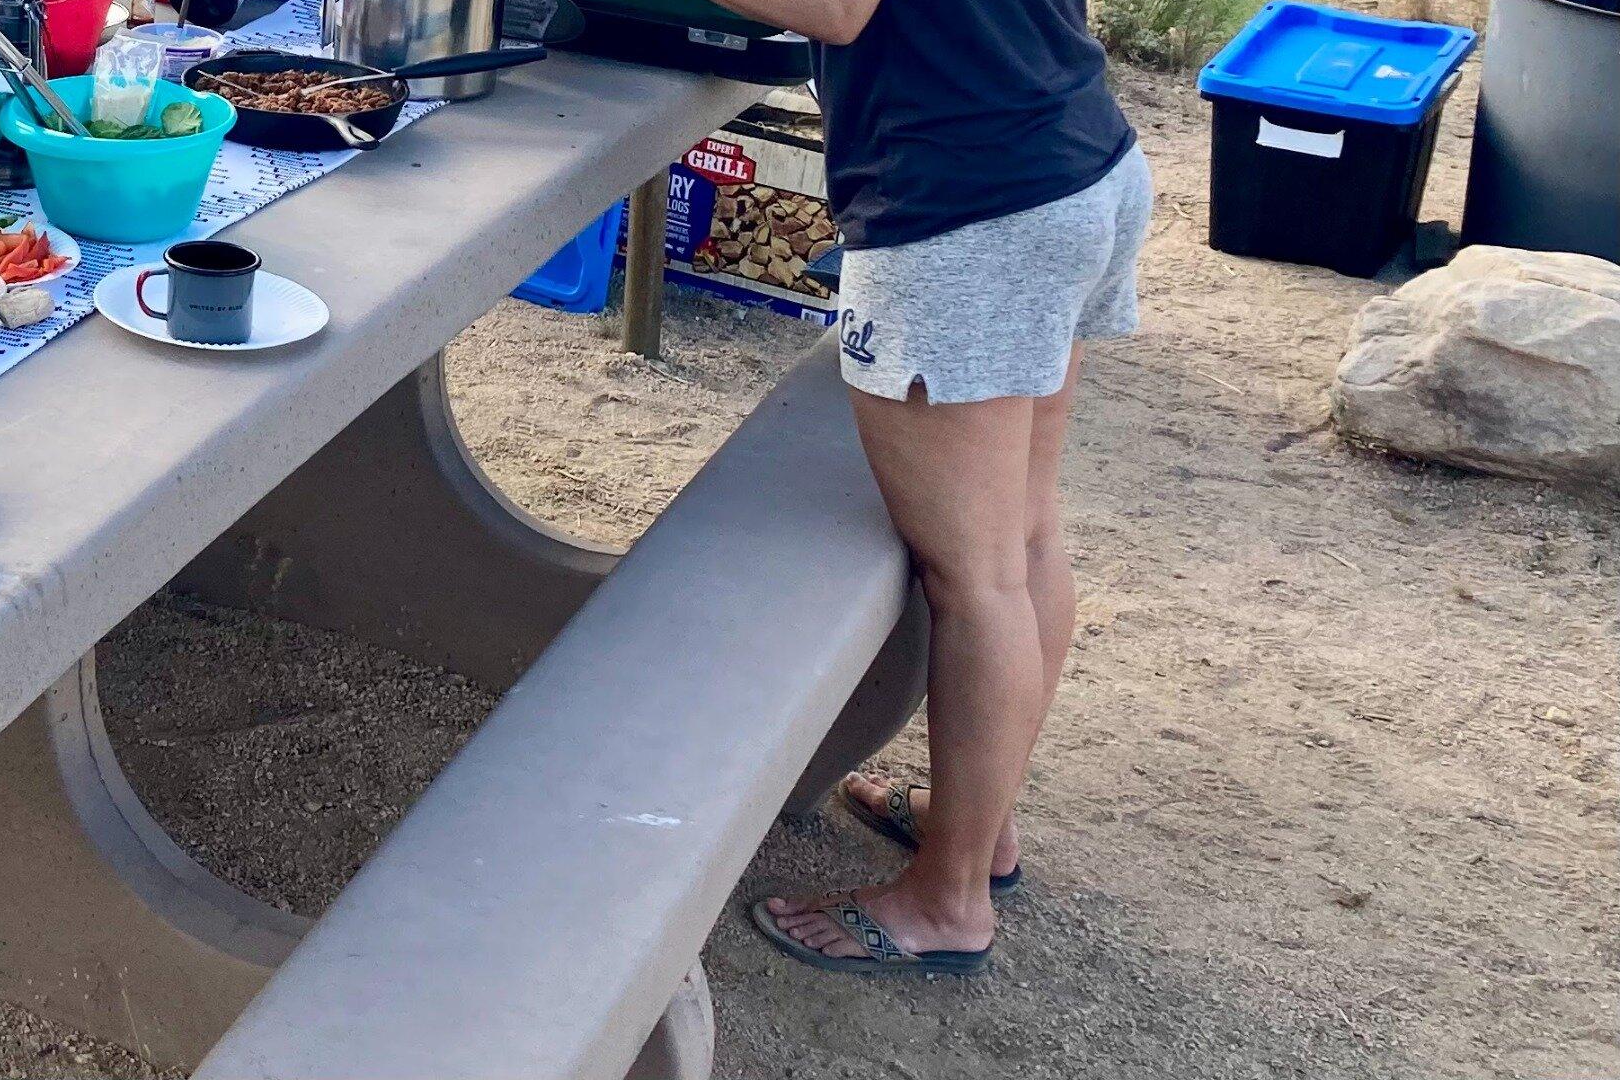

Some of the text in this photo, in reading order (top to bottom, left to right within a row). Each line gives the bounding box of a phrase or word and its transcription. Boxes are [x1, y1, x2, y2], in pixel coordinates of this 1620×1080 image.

[706, 140, 736, 155] EXPERT
[687, 149, 748, 180] GRILL
[668, 173, 695, 200] RY
